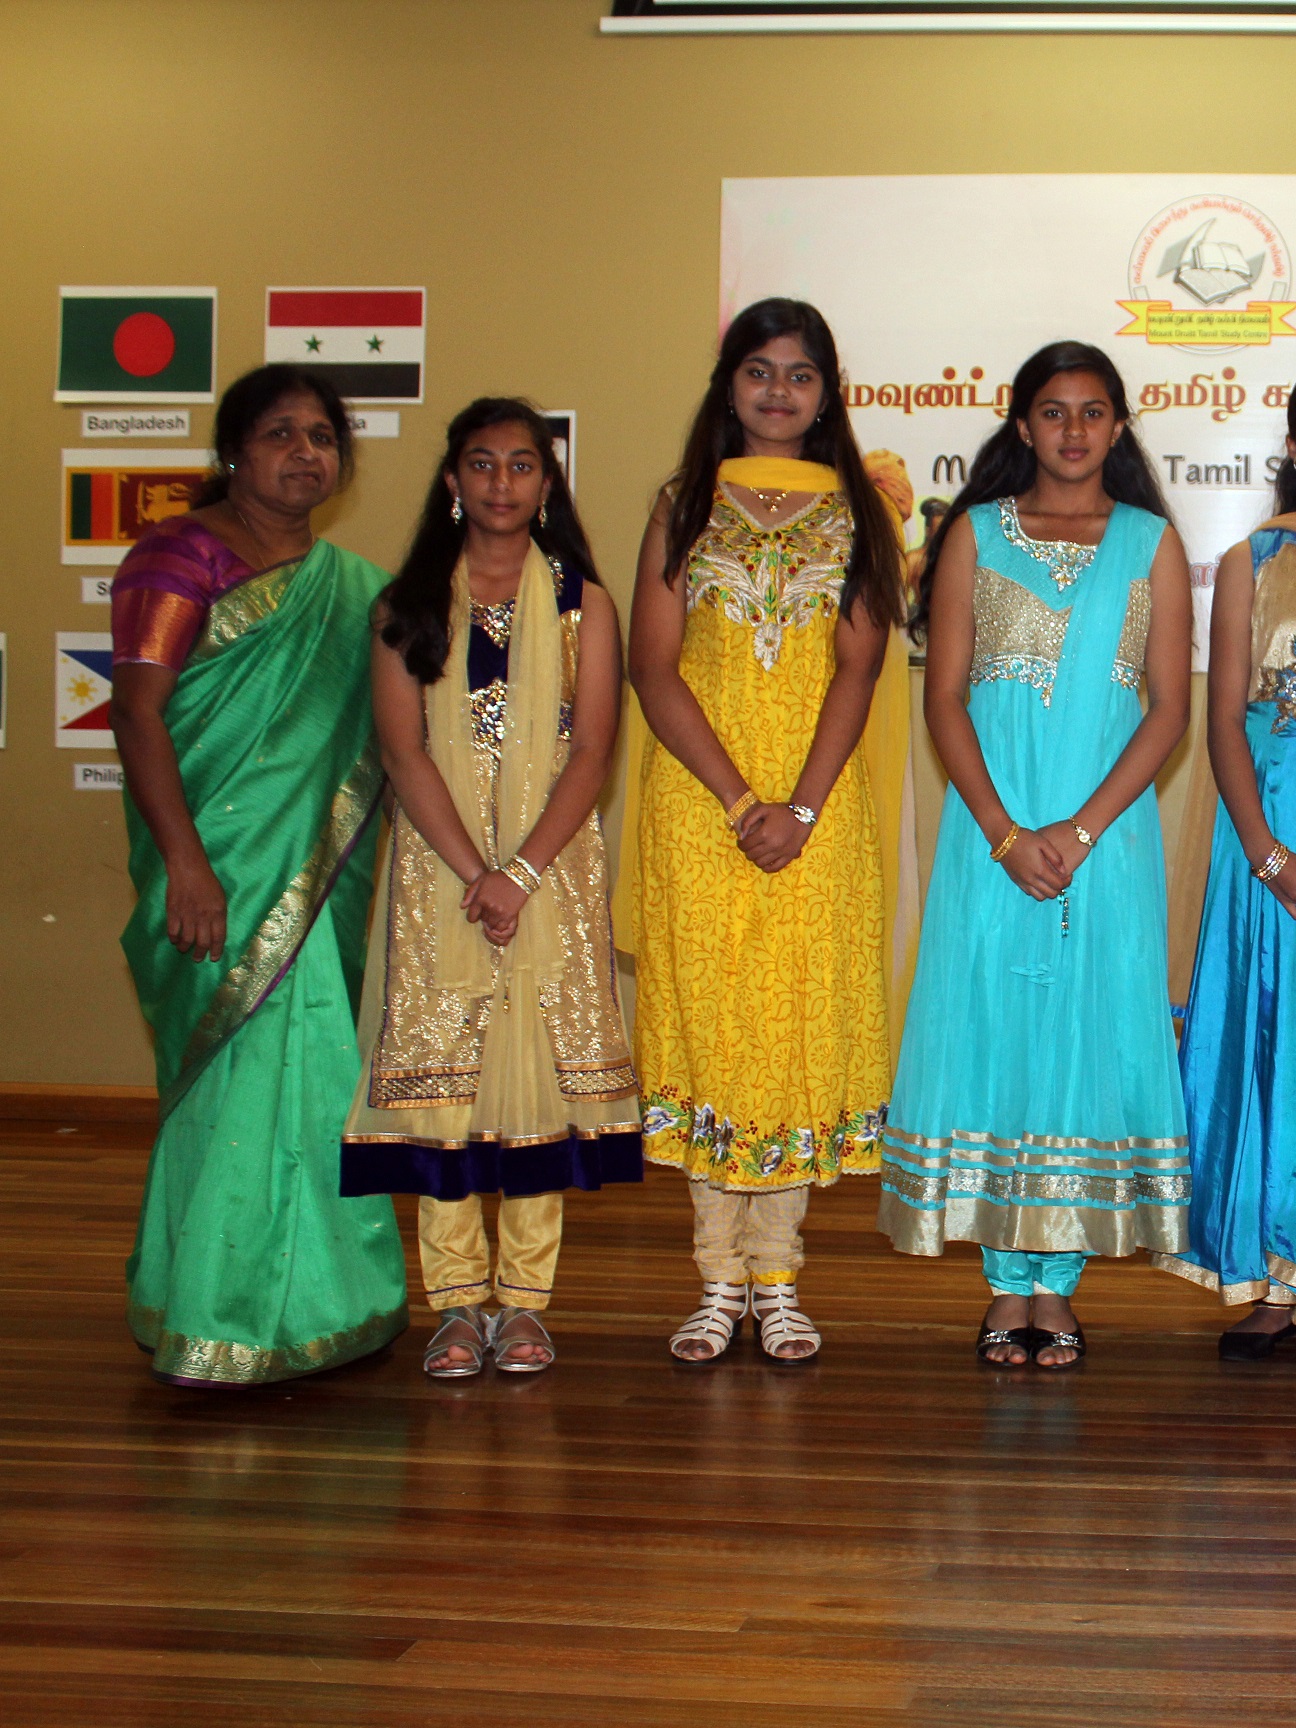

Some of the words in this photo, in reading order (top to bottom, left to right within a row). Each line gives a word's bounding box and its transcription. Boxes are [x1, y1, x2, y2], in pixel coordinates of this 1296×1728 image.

[1137, 366, 1246, 422] தமிழ்
[87, 415, 185, 433] Bangladesh
[1163, 454, 1250, 485] Tamil
